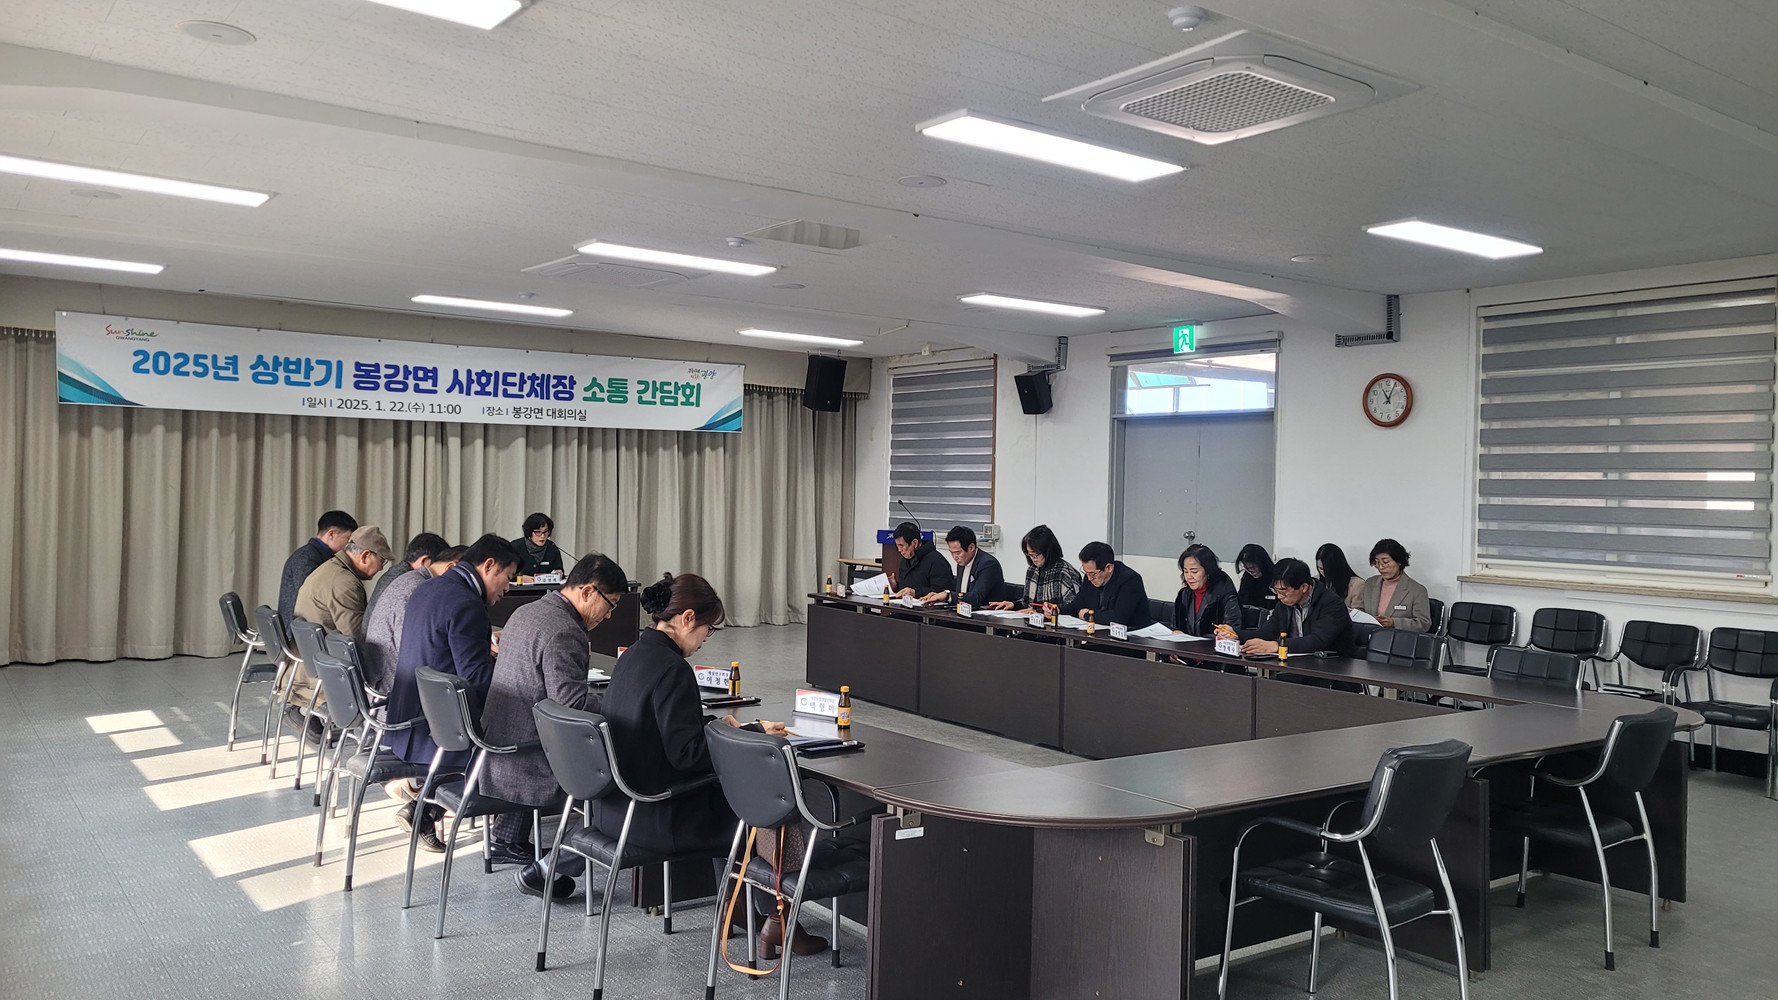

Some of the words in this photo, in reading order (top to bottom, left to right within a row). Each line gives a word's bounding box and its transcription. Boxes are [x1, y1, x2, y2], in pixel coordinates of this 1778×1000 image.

[132, 349, 240, 382] 2025년
[249, 354, 344, 389] 상반기
[353, 361, 439, 395] 봉강면
[446, 368, 577, 401] 사회단체장
[582, 376, 629, 404] 소통
[636, 380, 701, 407] 간담회
[336, 398, 372, 411] 2025.
[375, 400, 386, 412] 1.
[389, 401, 425, 414] 22.(수)
[428, 403, 462, 415] 11:00
[511, 406, 544, 419] 봉강면
[546, 408, 587, 422] 대회의실
